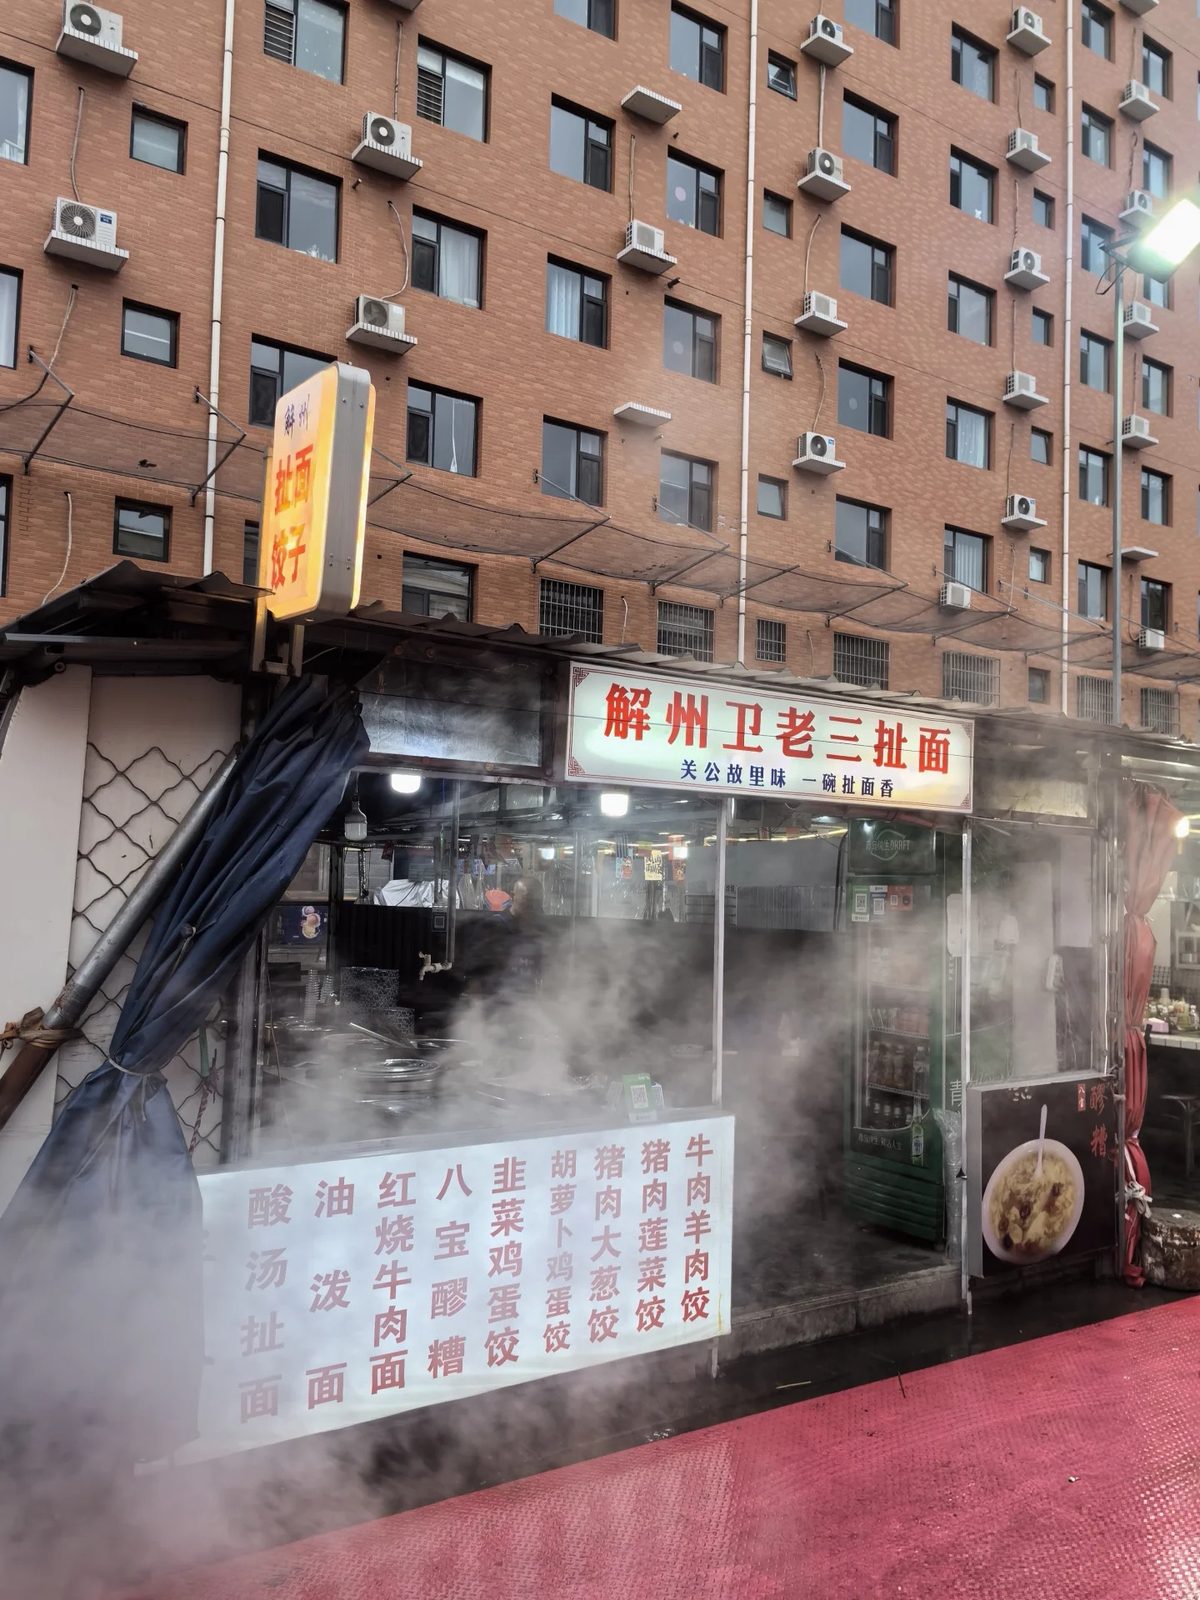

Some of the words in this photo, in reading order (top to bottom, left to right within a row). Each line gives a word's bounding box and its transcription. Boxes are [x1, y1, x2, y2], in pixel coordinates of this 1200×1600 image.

[271, 523, 306, 589] 饺子
[274, 443, 314, 516] 扯面
[604, 683, 952, 775] 解州卫老三扯面
[680, 758, 787, 789] 关公故里味
[802, 773, 895, 799] 一碗扯面香
[238, 1183, 294, 1424] 酸汤扯面
[305, 1176, 355, 1410] 油泼面
[370, 1171, 417, 1395] 红烧牛肉面
[427, 1163, 473, 1379] 八宝醪糟
[484, 1156, 528, 1368] 韭菜鸡蛋饺
[542, 1149, 577, 1354] 胡萝卜鸡蛋饺
[587, 1144, 626, 1344] 猪肉大葱饺
[635, 1138, 671, 1333] 猪肉莲菜饺
[680, 1133, 714, 1323] 牛肉羊肉饺
